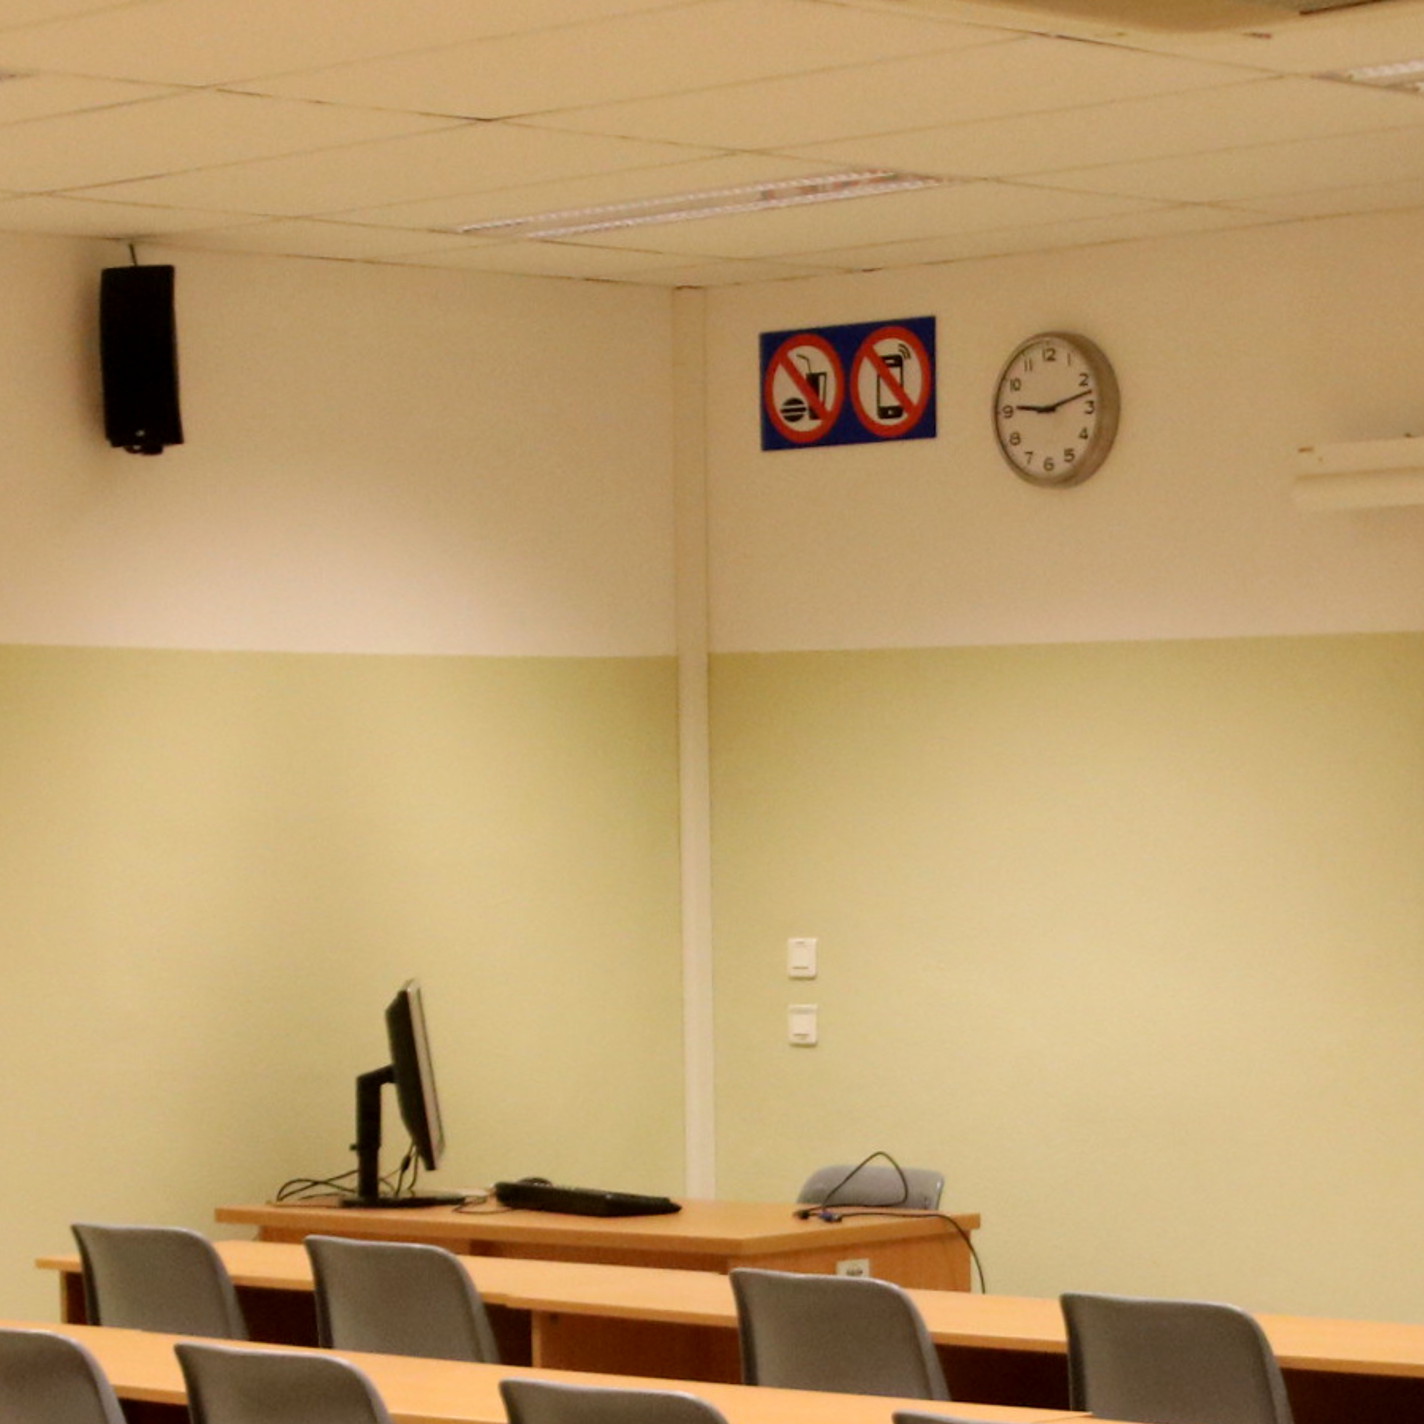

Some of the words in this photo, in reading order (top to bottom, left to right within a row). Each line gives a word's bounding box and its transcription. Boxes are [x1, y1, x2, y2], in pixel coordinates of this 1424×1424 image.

[1042, 348, 1055, 361] 12
[1024, 359, 1033, 372] 11
[1009, 378, 1021, 391] 10
[1079, 373, 1089, 387] 2
[1003, 405, 1013, 418] 9
[1084, 401, 1095, 414] 3
[1009, 433, 1020, 445] 8
[1078, 428, 1088, 440] 4
[1024, 452, 1034, 464] 7
[1064, 448, 1075, 462] 5
[1044, 458, 1054, 471] 6
